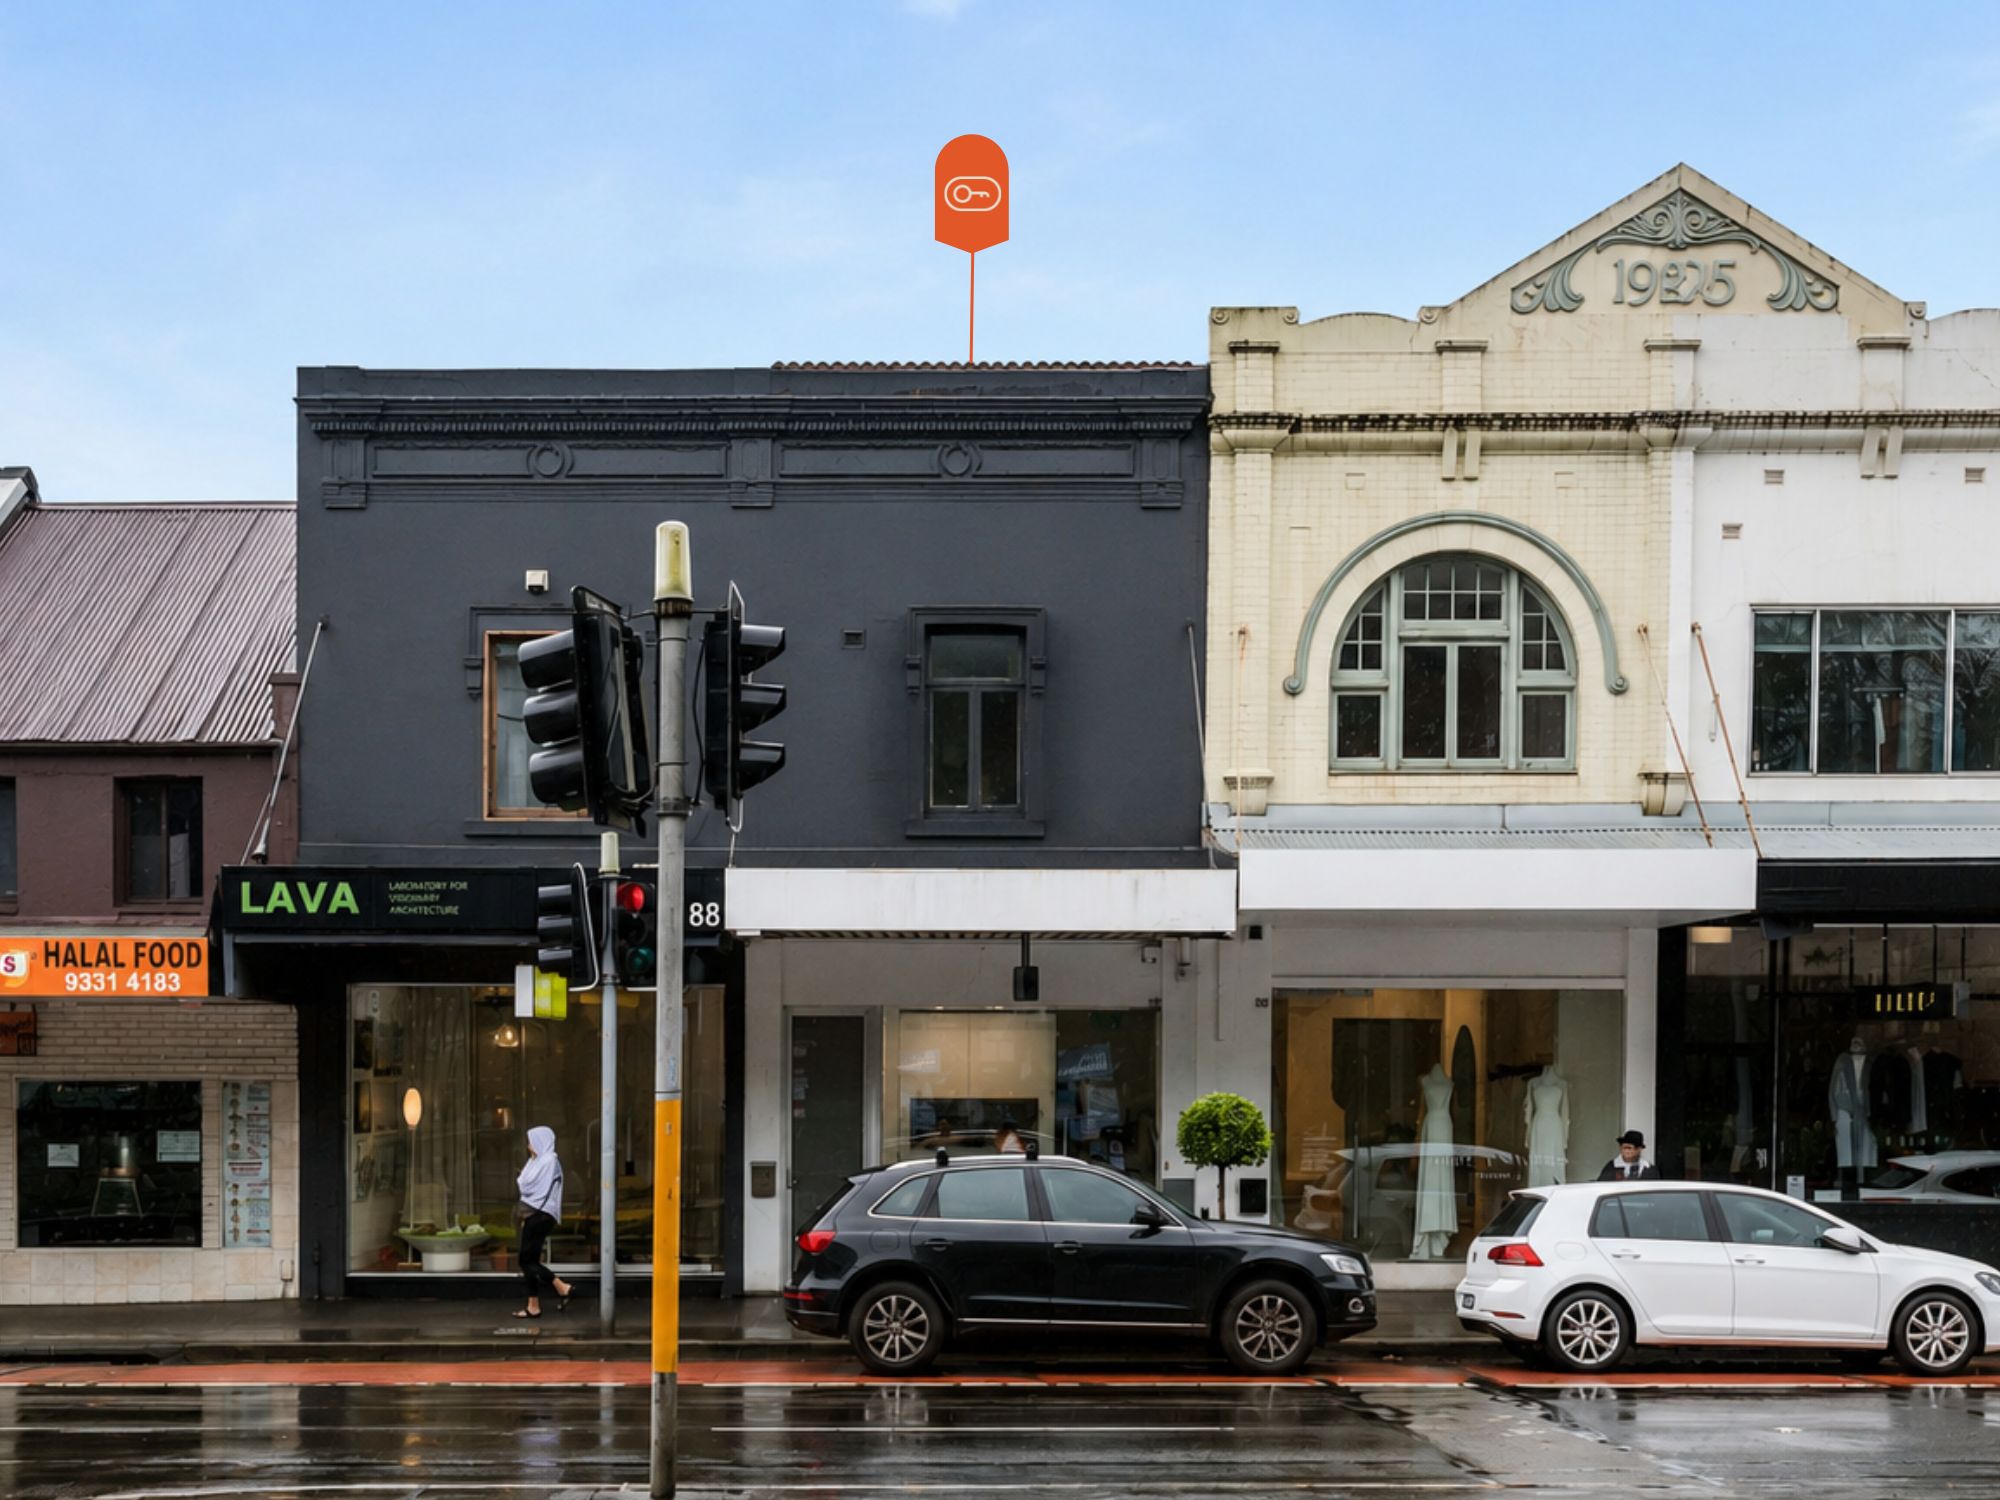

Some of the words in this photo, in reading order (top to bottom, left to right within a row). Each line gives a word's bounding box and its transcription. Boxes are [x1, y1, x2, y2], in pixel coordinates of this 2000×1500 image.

[241, 881, 360, 914] LAVA
[689, 902, 720, 927] 88
[44, 941, 125, 968] HALAL
[134, 942, 202, 968] FOOD
[65, 972, 117, 992] 9331
[126, 972, 182, 992] 4183
